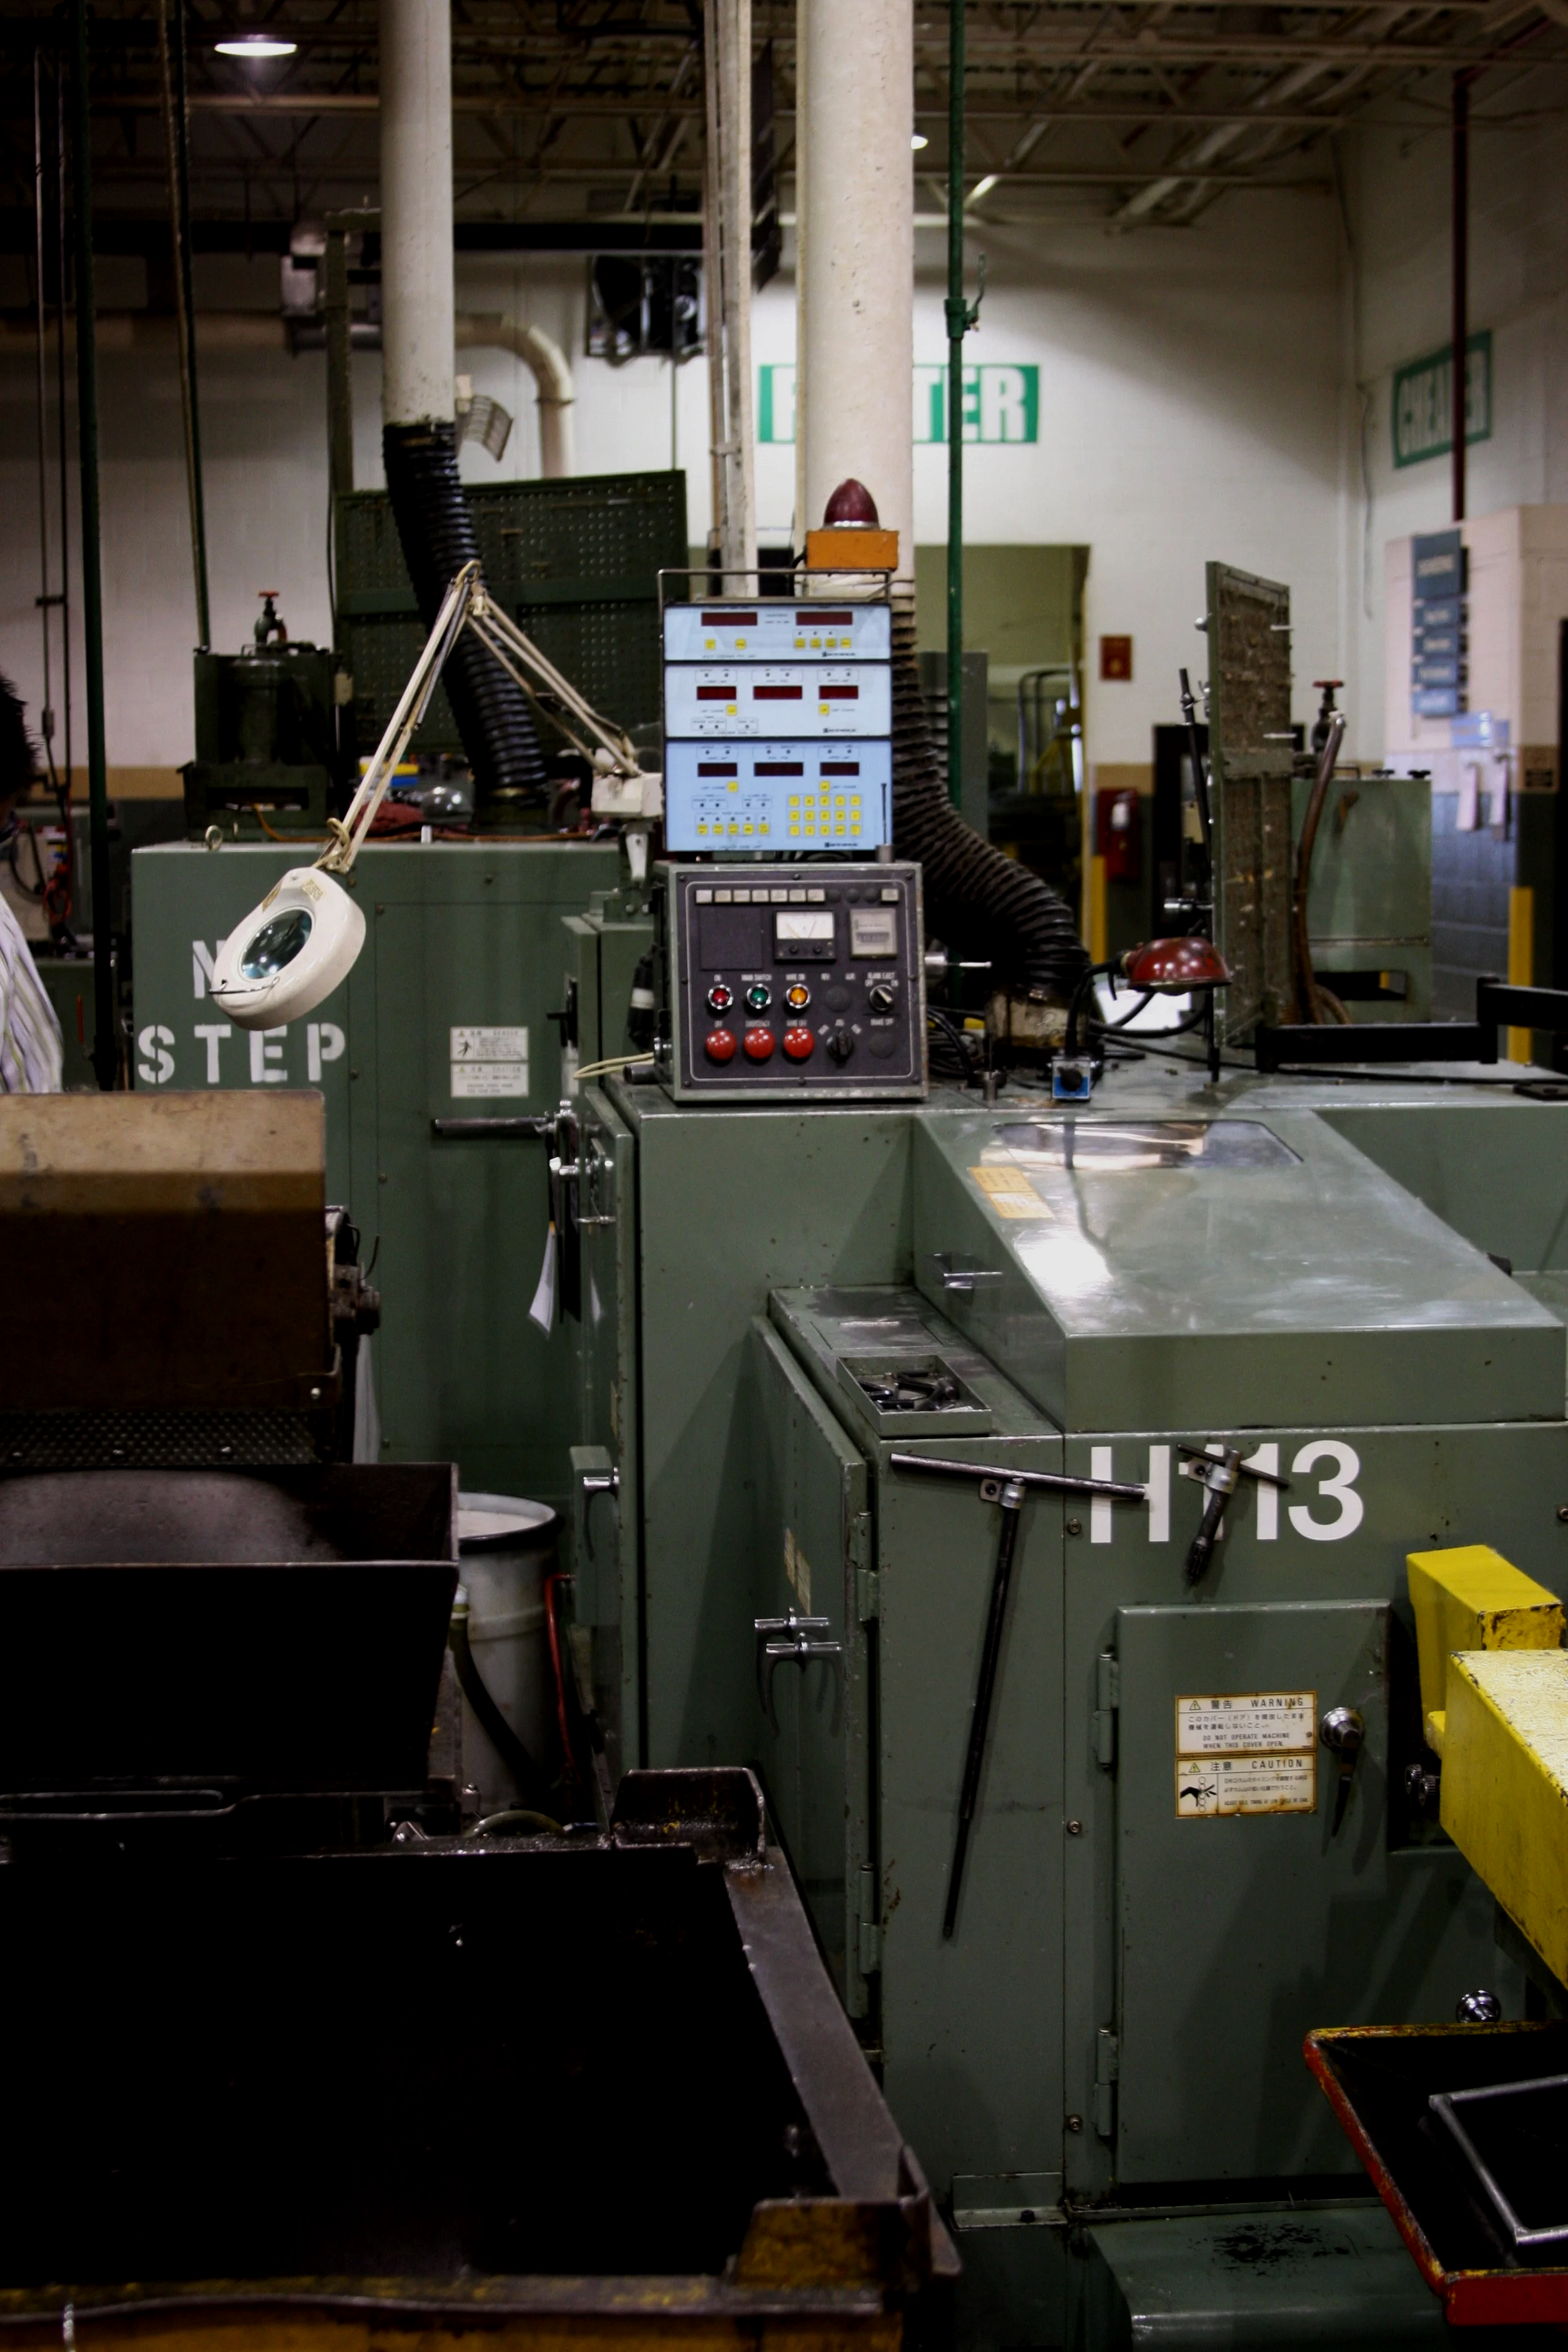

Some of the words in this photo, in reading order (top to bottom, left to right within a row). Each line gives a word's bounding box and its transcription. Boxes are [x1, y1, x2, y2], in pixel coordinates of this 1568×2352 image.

[138, 1022, 346, 1084] STEP
[1251, 1698, 1303, 1707] WARNING
[1252, 1759, 1302, 1769] CAUTION
